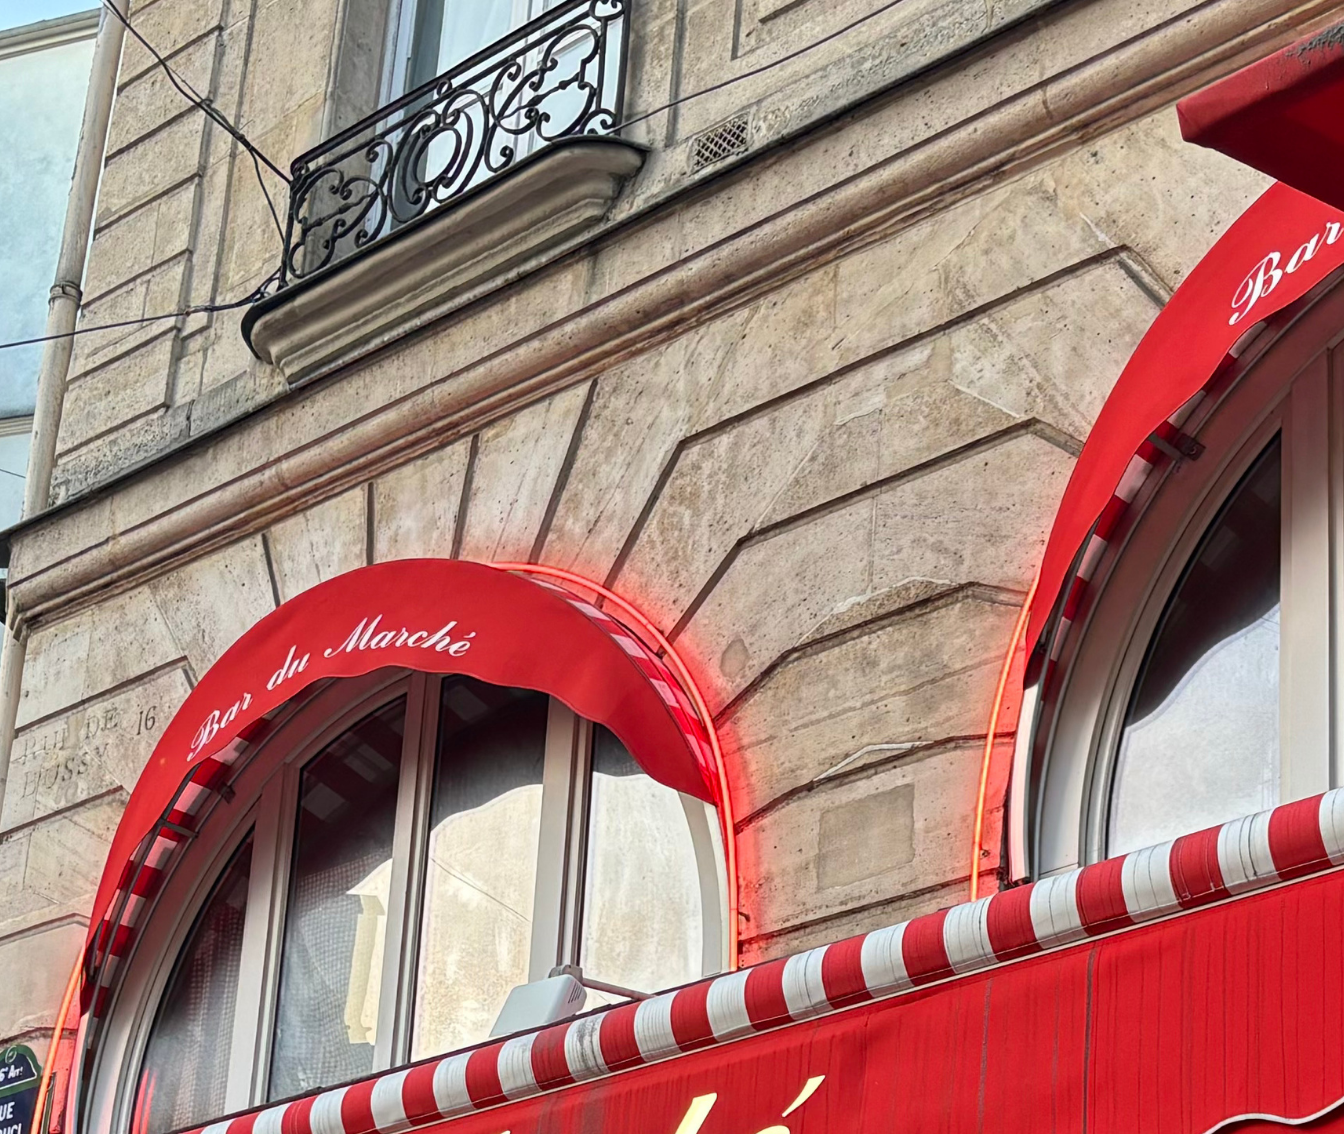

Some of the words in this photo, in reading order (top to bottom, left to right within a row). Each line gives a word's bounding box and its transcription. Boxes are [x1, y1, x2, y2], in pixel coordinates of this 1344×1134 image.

[1228, 221, 1344, 326] Bar
[186, 692, 254, 762] Bar
[266, 645, 311, 691] du
[323, 613, 477, 658] Marché
